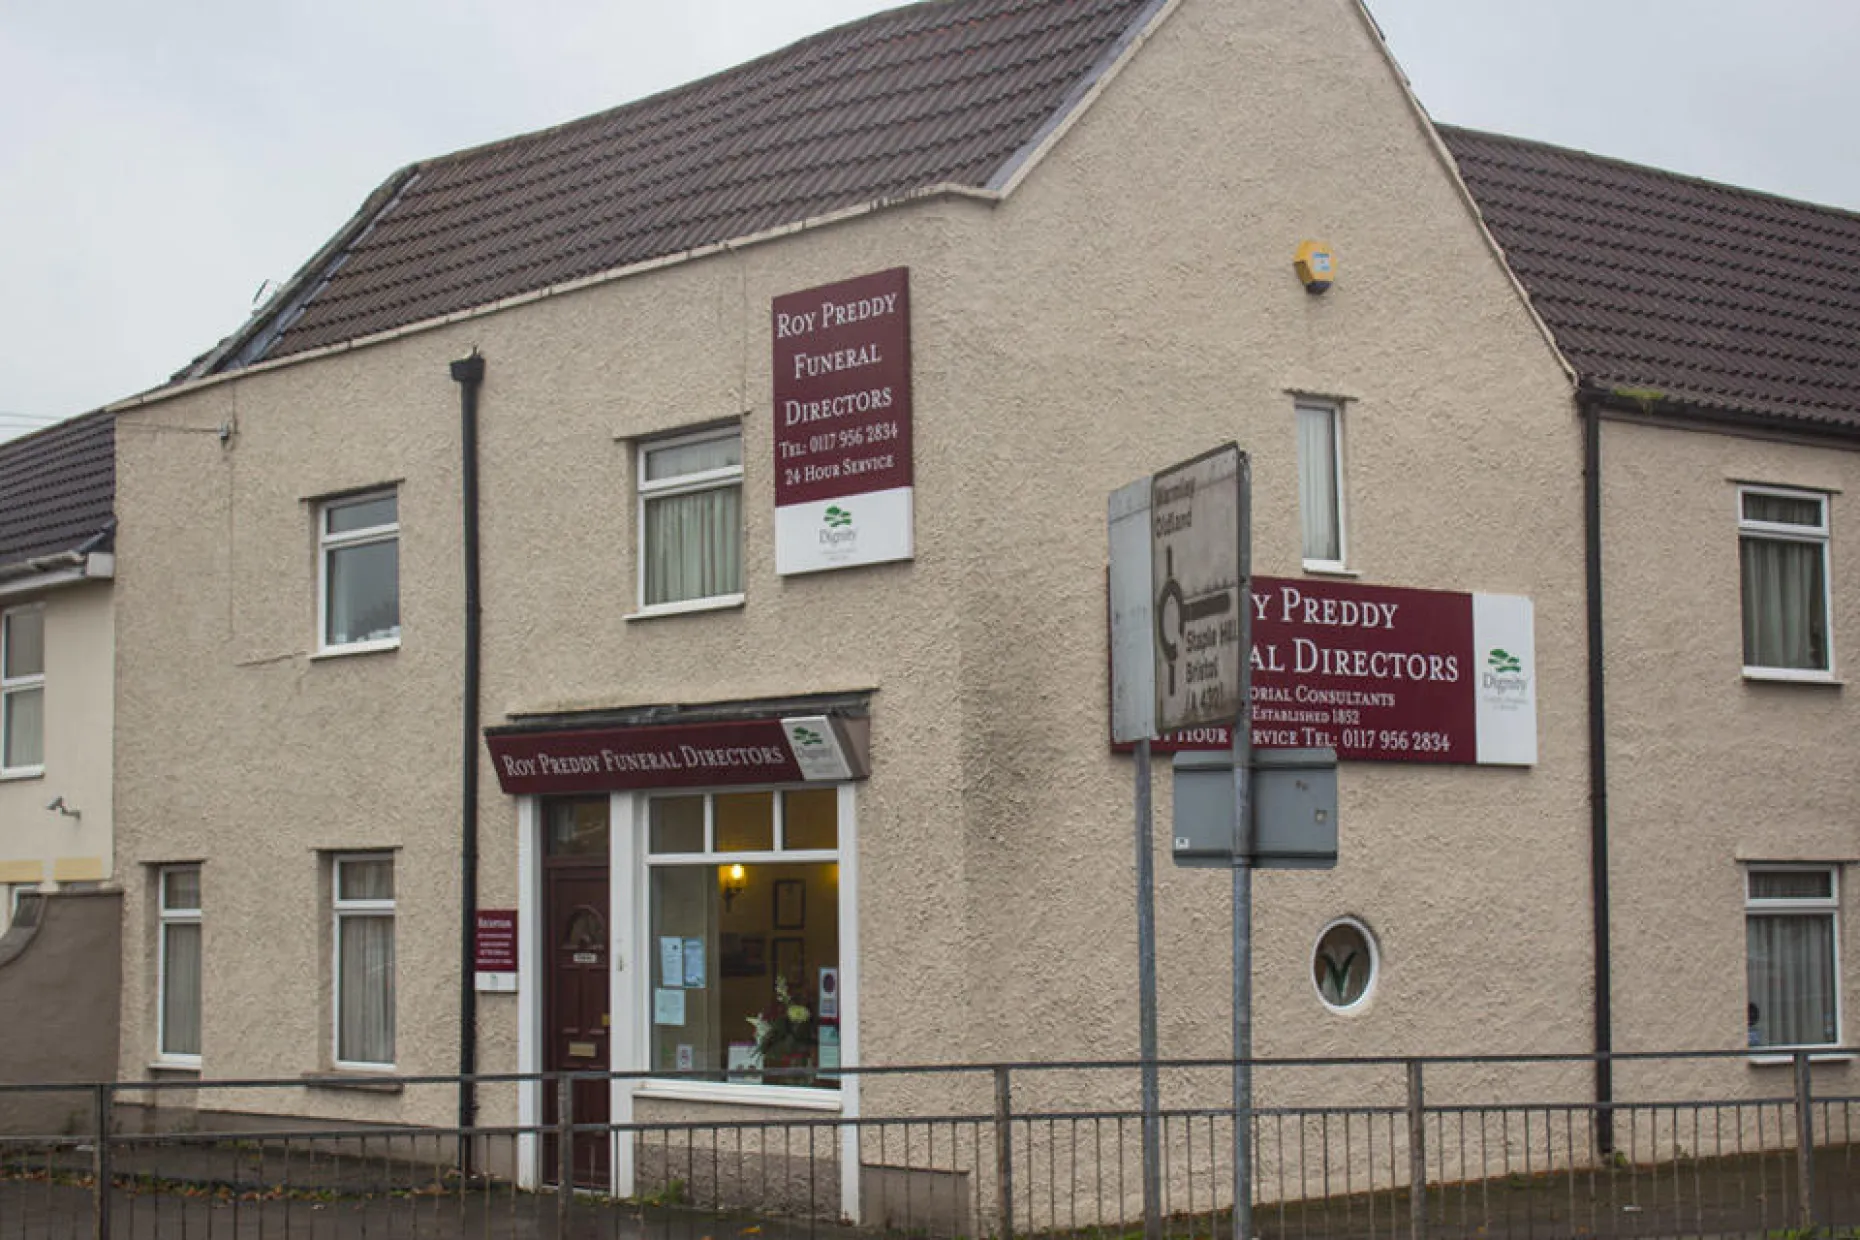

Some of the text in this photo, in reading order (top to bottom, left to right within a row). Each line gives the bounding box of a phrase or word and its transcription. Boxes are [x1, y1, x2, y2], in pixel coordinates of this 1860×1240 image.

[776, 292, 898, 338] ROY PREDDY
[794, 344, 882, 379] FUNERAL
[785, 387, 892, 426] DIRECTORS
[809, 432, 836, 454] 0117
[838, 428, 863, 449] 956
[865, 420, 898, 444] 2834
[785, 454, 894, 485] 24 HOUR SERVICE
[1280, 586, 1399, 629] PREDDY
[1292, 637, 1459, 682] DIRECTORS
[1295, 684, 1396, 707] CONSULTANTS
[1301, 726, 1338, 748] TEL:
[1342, 728, 1377, 749] 0117
[1379, 730, 1406, 752] 956
[1412, 731, 1450, 753] 2834
[502, 754, 537, 778] ROY
[538, 752, 600, 776] PREDDY
[601, 749, 682, 773] FUNERAL
[680, 744, 786, 769] DIRECTORS
